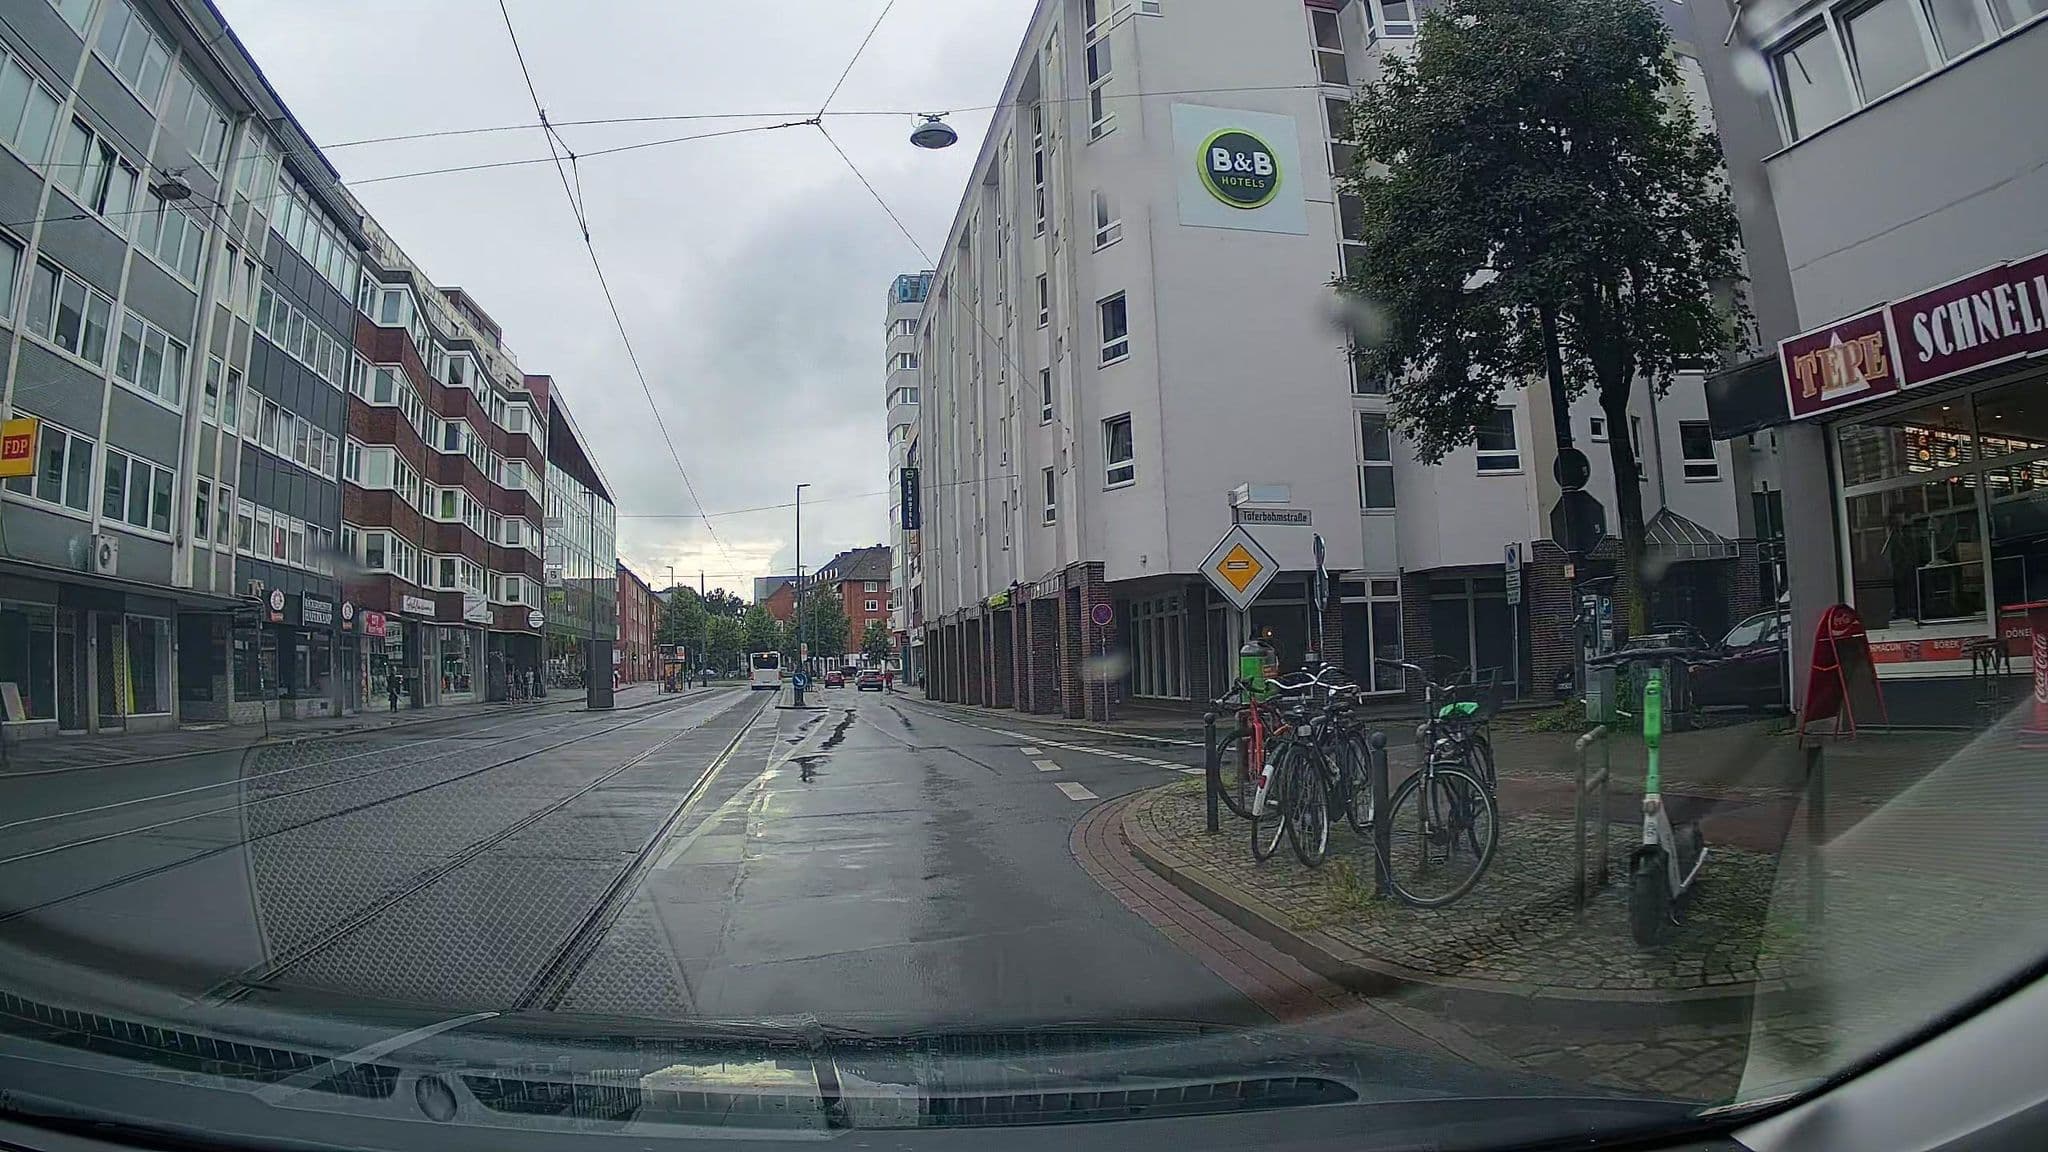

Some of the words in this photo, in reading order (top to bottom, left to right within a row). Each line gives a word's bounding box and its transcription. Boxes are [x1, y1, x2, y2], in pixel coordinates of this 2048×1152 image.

[1211, 147, 1273, 176] B&B
[1221, 176, 1265, 188] HOTELS
[1794, 331, 1889, 398] TEPE
[4, 439, 28, 454] FDP
